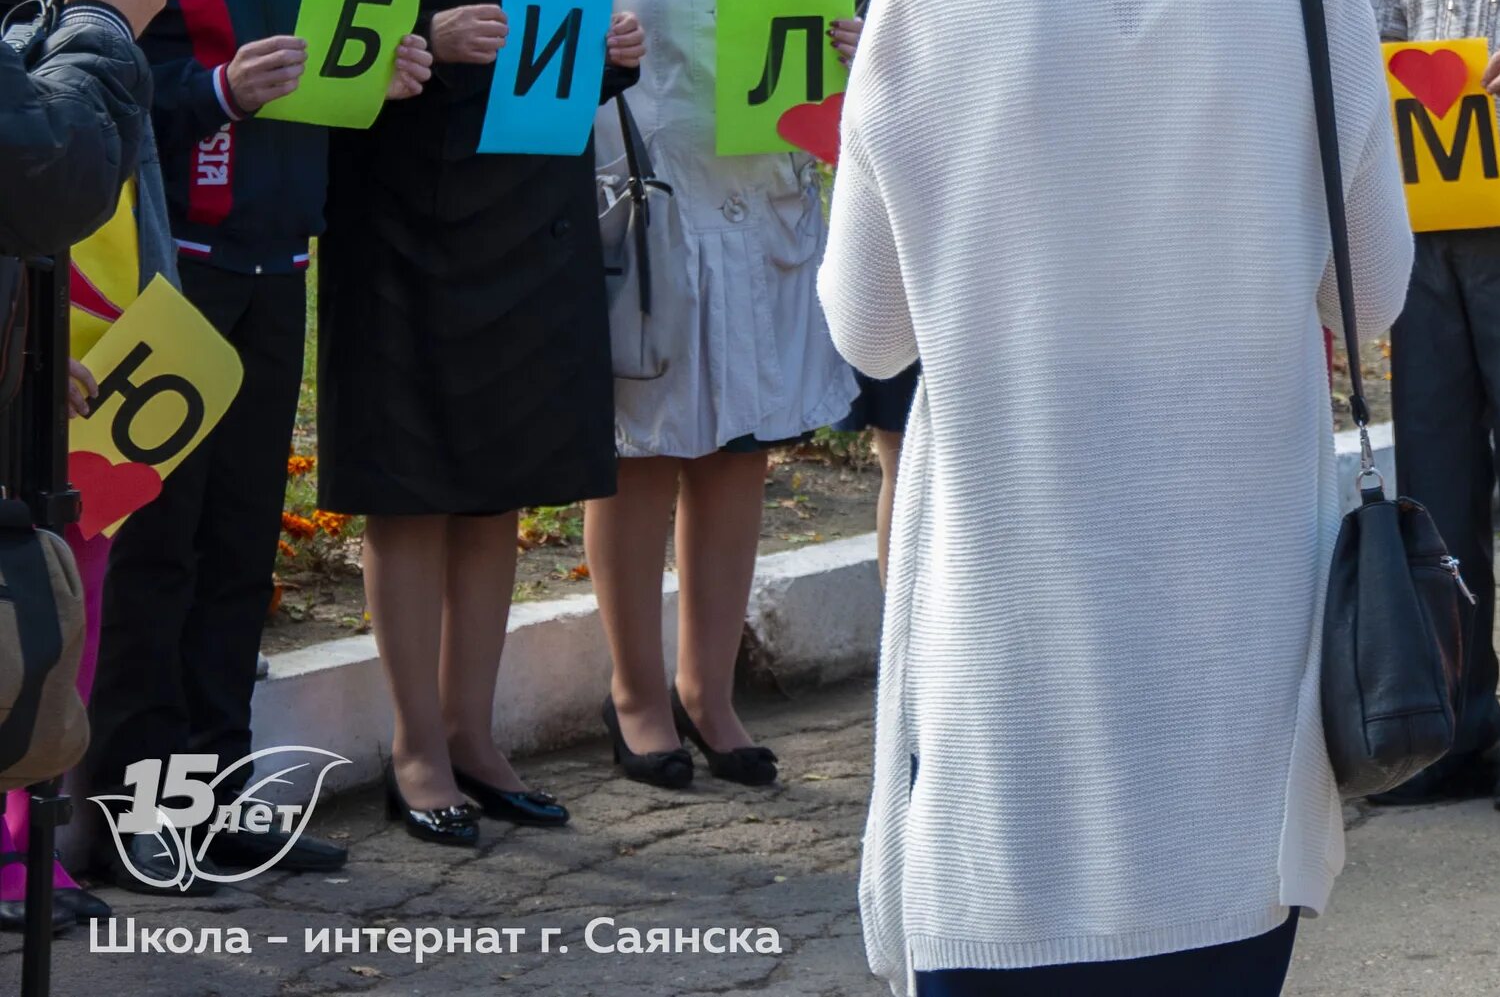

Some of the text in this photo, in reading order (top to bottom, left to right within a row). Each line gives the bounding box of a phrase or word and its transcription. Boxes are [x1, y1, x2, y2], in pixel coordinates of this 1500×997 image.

[513, 5, 583, 99] И
[747, 15, 825, 106] Л
[1394, 93, 1499, 184] М
[80, 340, 205, 466] Ю
